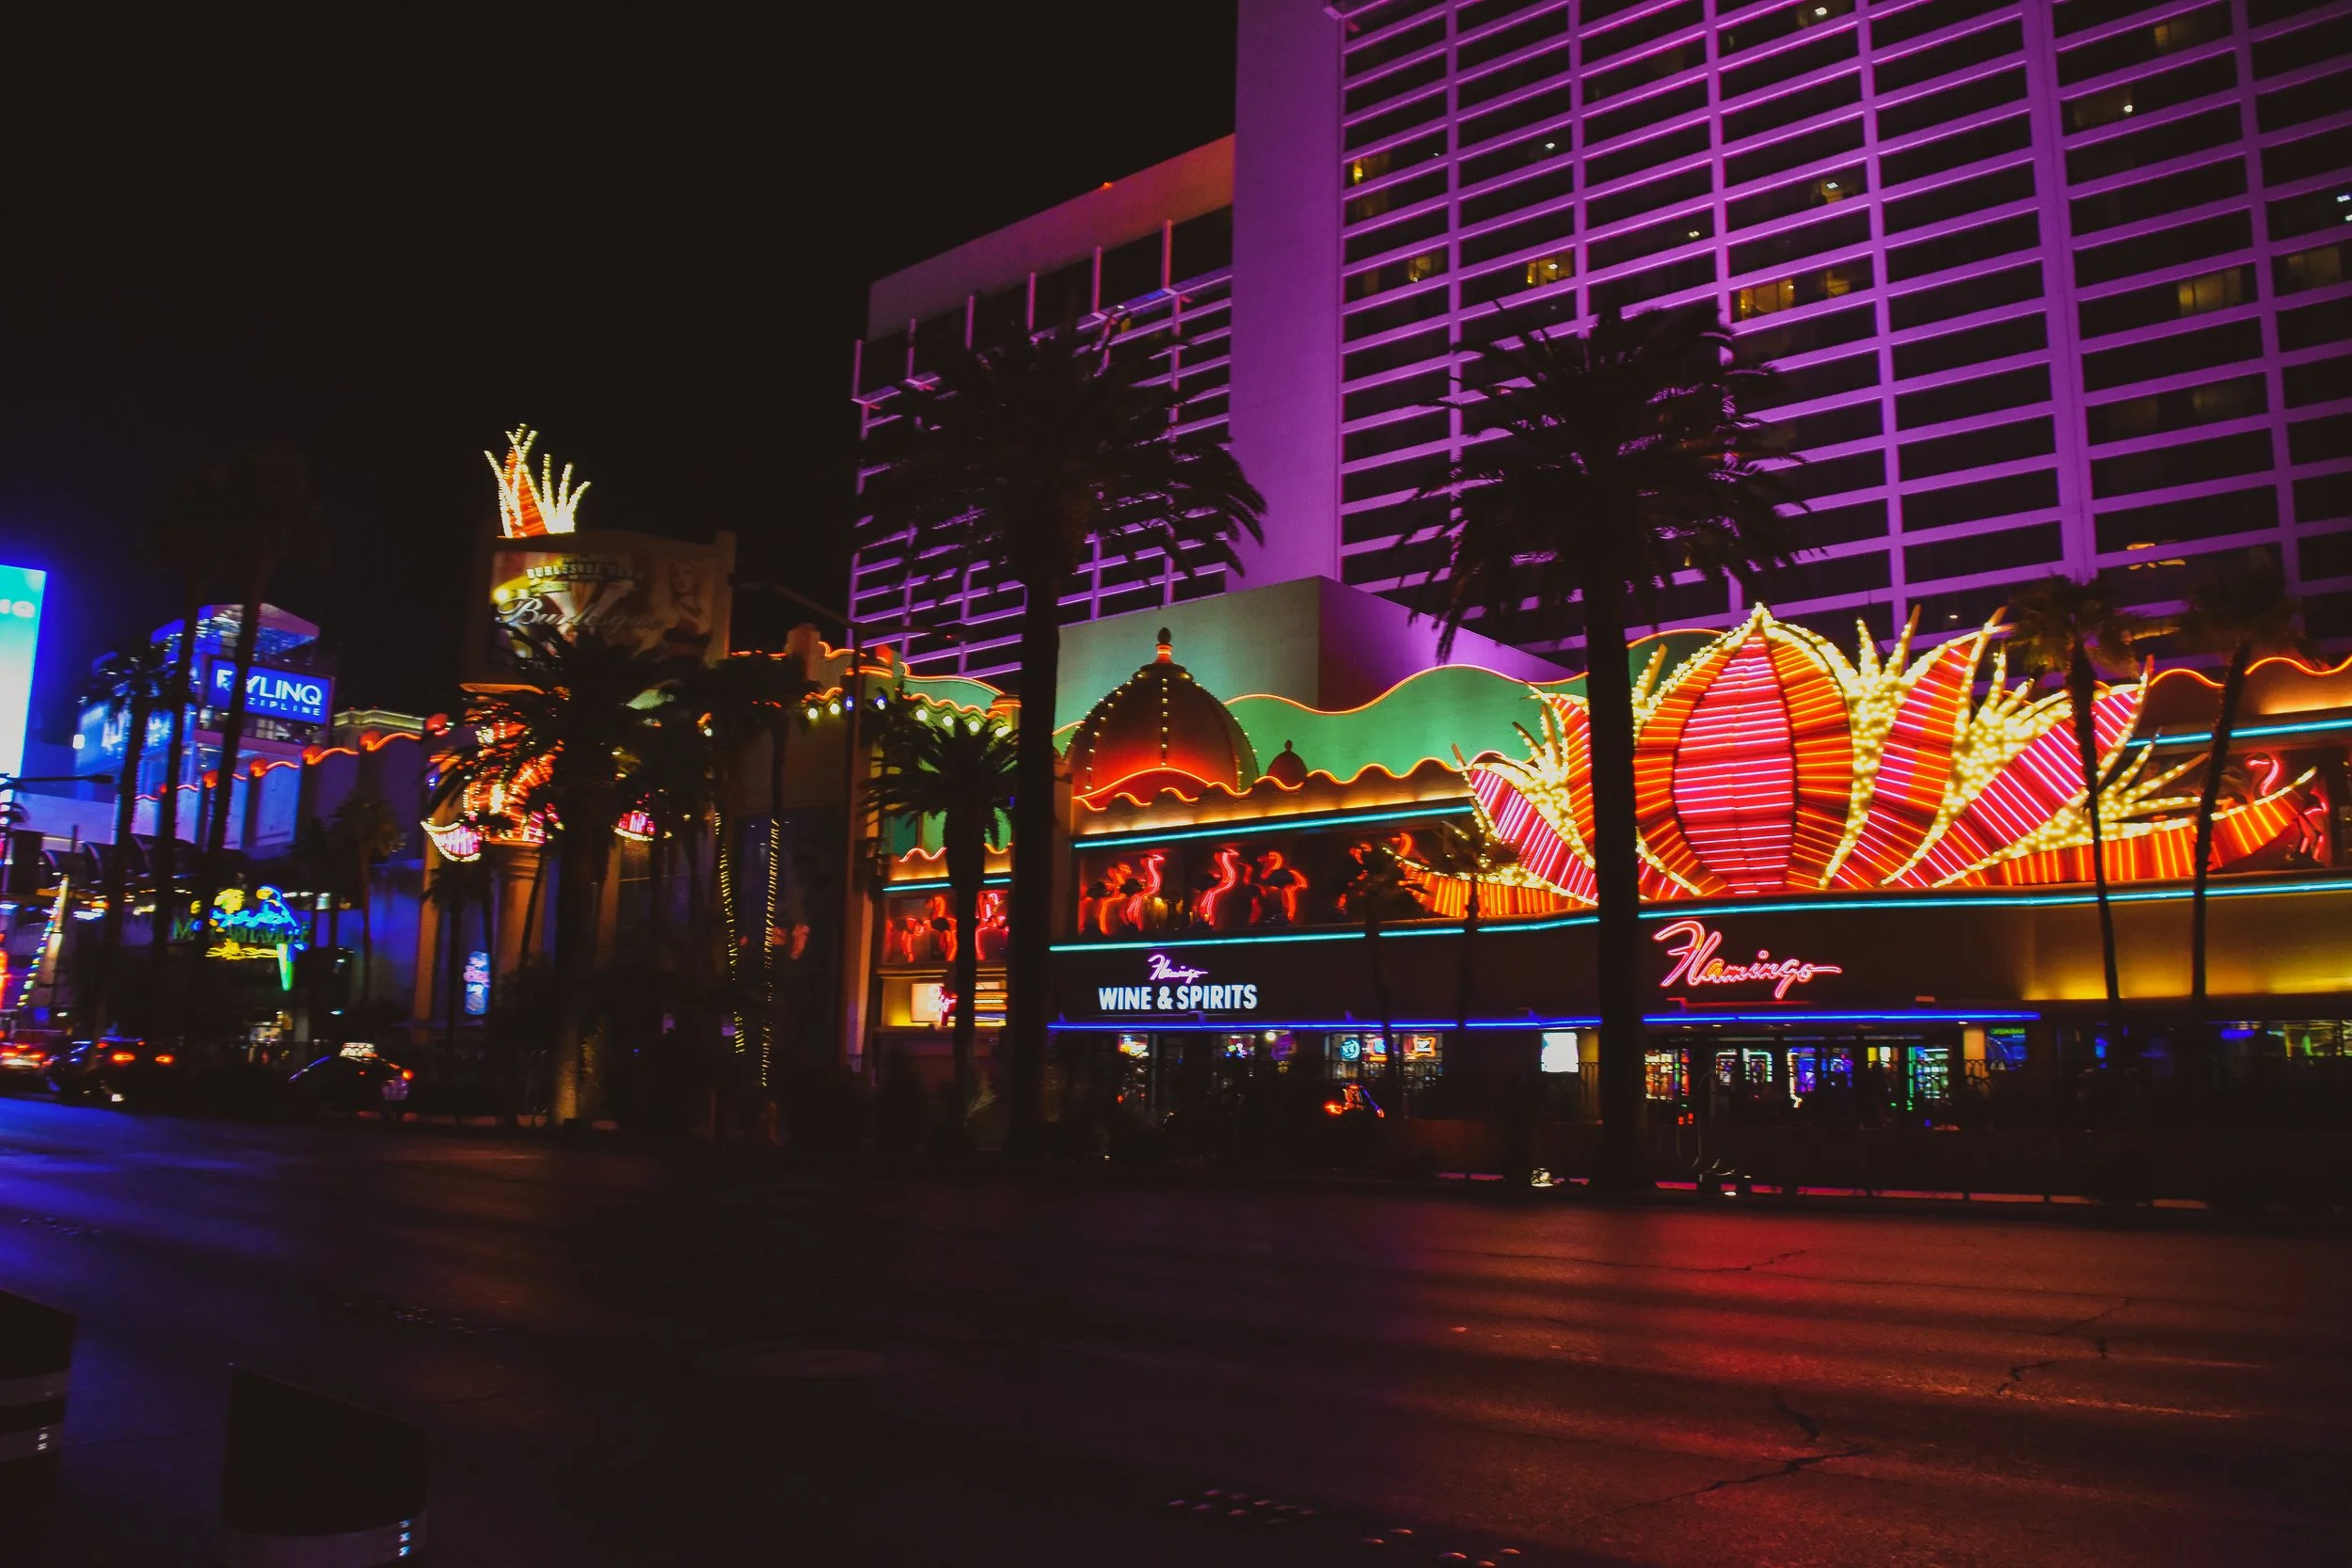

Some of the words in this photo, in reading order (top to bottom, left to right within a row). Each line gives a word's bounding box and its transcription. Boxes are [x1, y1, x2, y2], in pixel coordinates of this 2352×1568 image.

[216, 669, 323, 705] FYLINQ
[247, 697, 321, 716] ZIPLINE
[1653, 920, 1842, 1000] Flamingo
[1098, 987, 1152, 1010] WINE
[1156, 986, 1173, 1010] &
[1176, 984, 1258, 1010] SPIRITS
